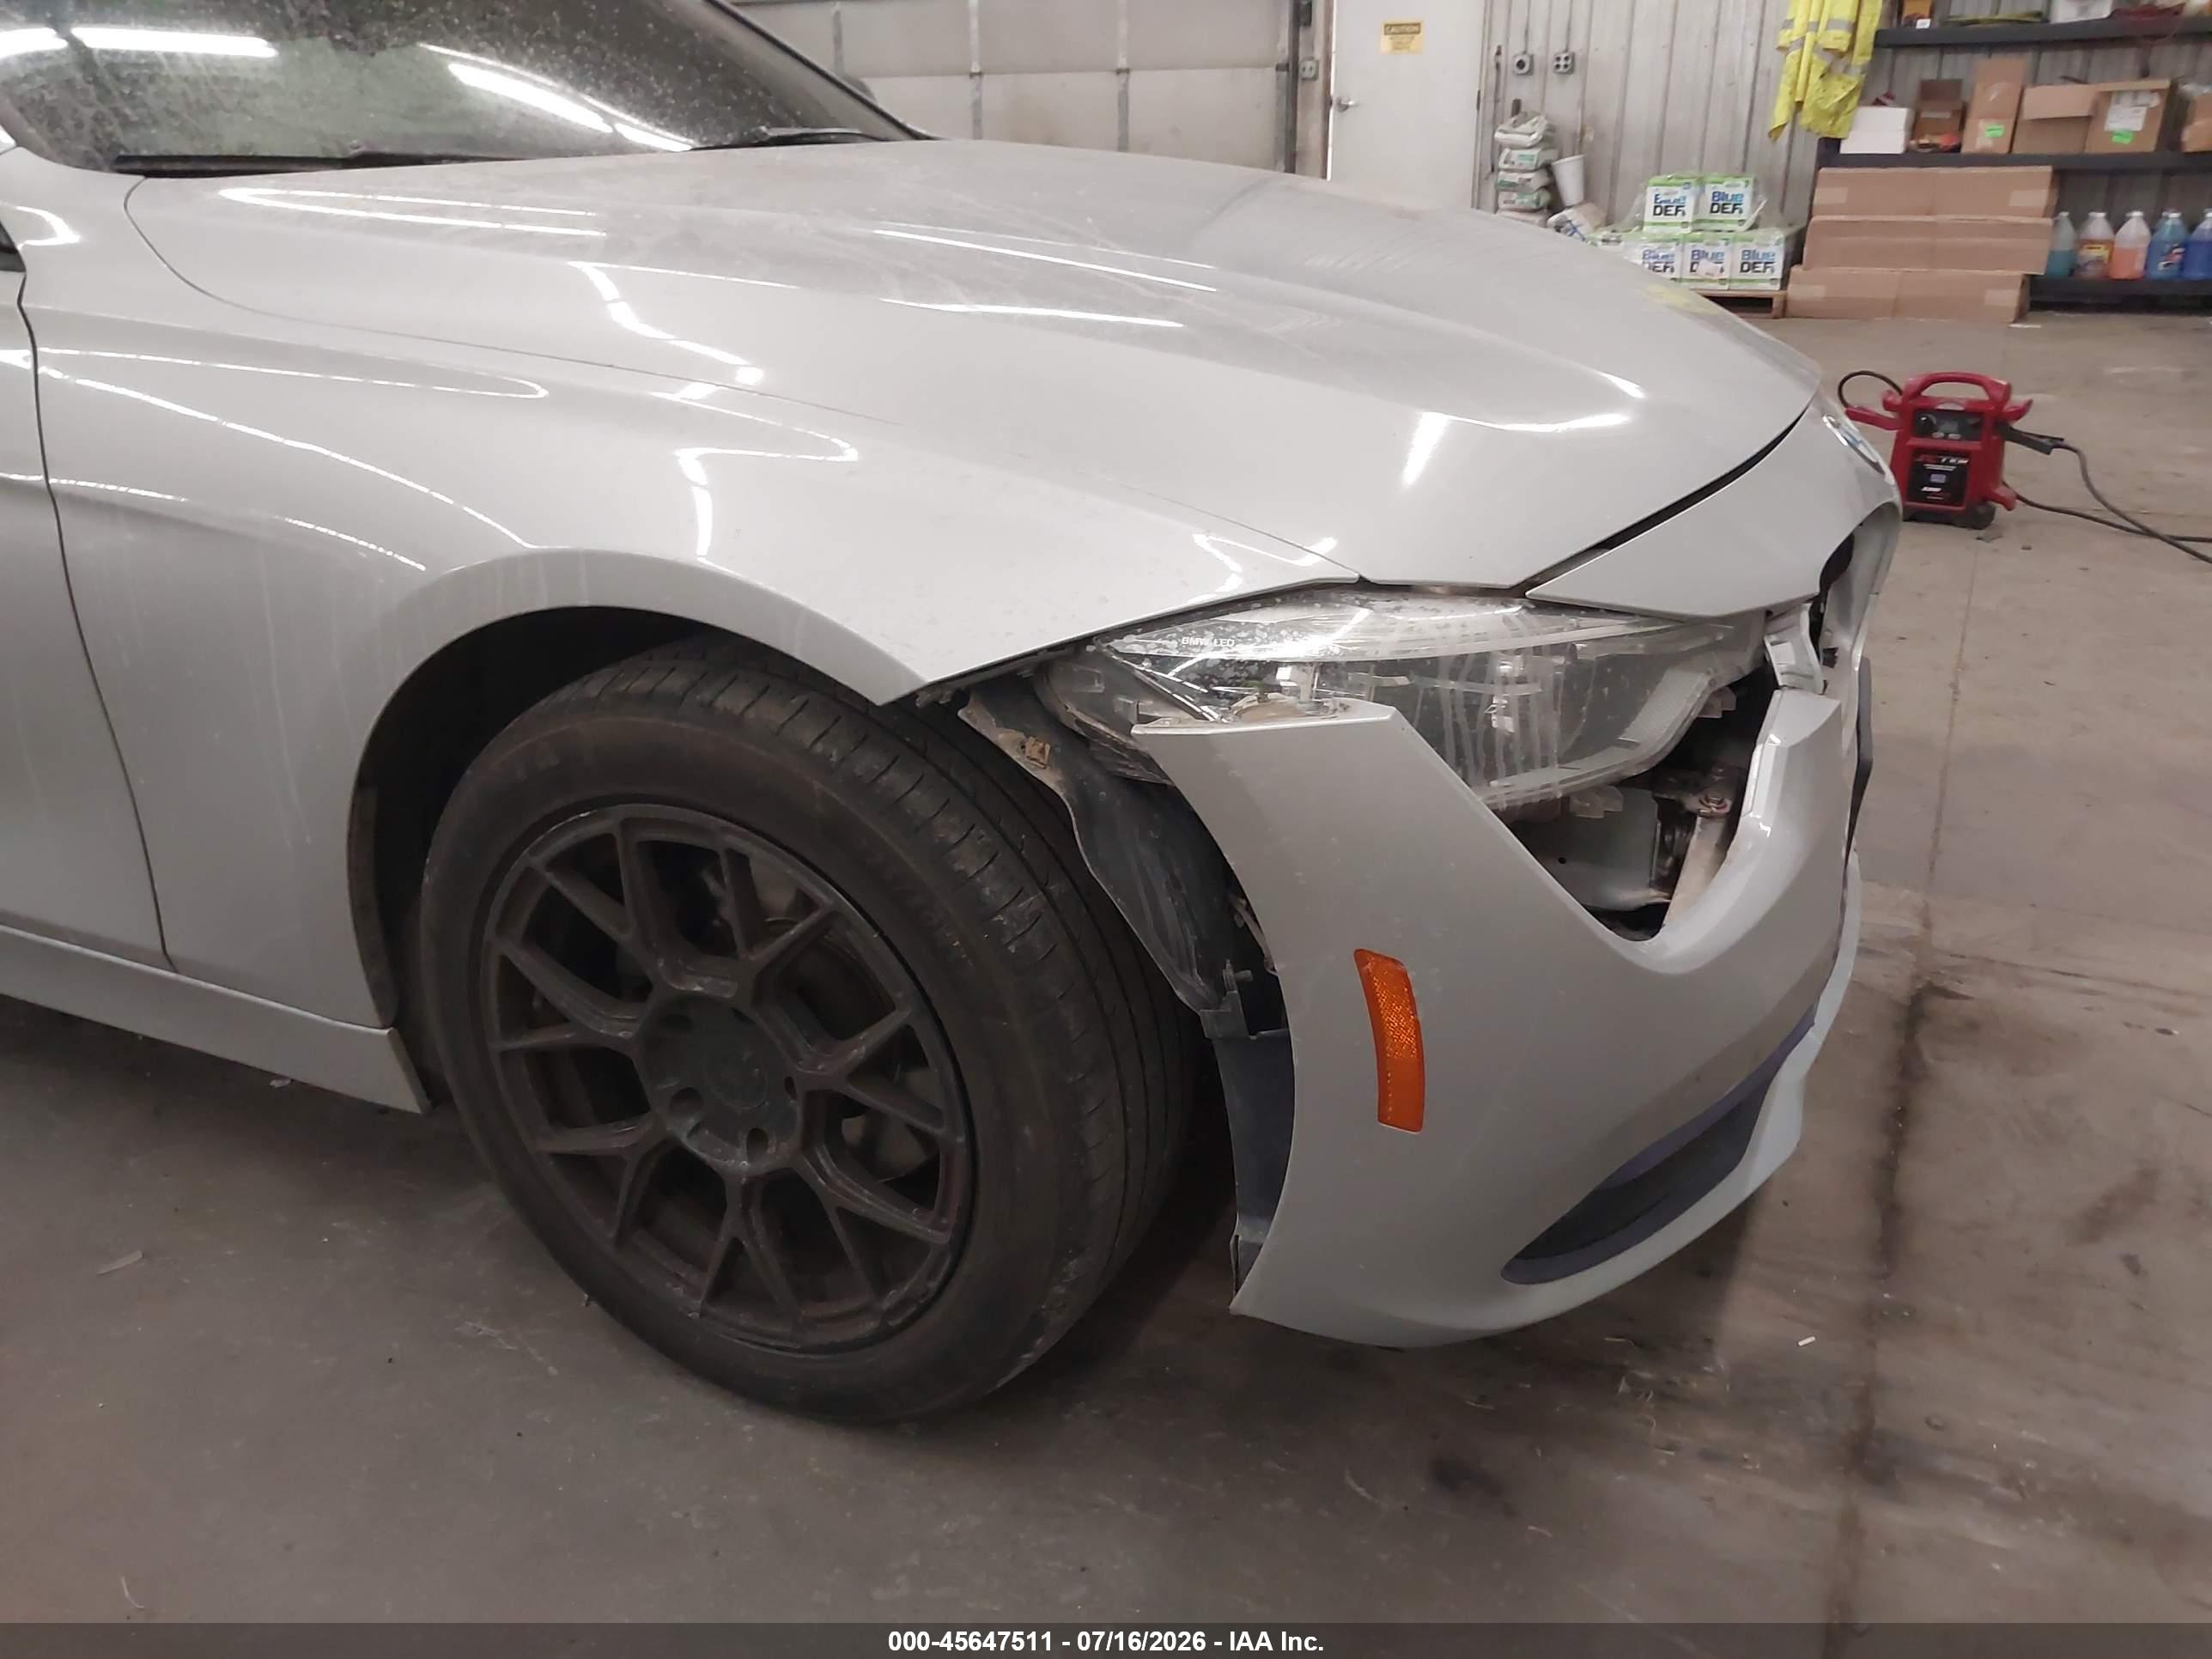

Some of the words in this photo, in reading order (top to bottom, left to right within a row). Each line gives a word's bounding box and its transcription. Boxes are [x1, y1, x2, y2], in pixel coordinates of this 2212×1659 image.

[1712, 191, 1745, 203] Blue
[1653, 205, 1686, 216] DEF
[1710, 203, 1744, 214] DEF
[1691, 250, 1724, 261] Blue
[1741, 250, 1775, 261] Blue
[1740, 261, 1774, 272] DEF
[1181, 636, 1208, 647] BMW
[1213, 638, 1235, 647] LED
